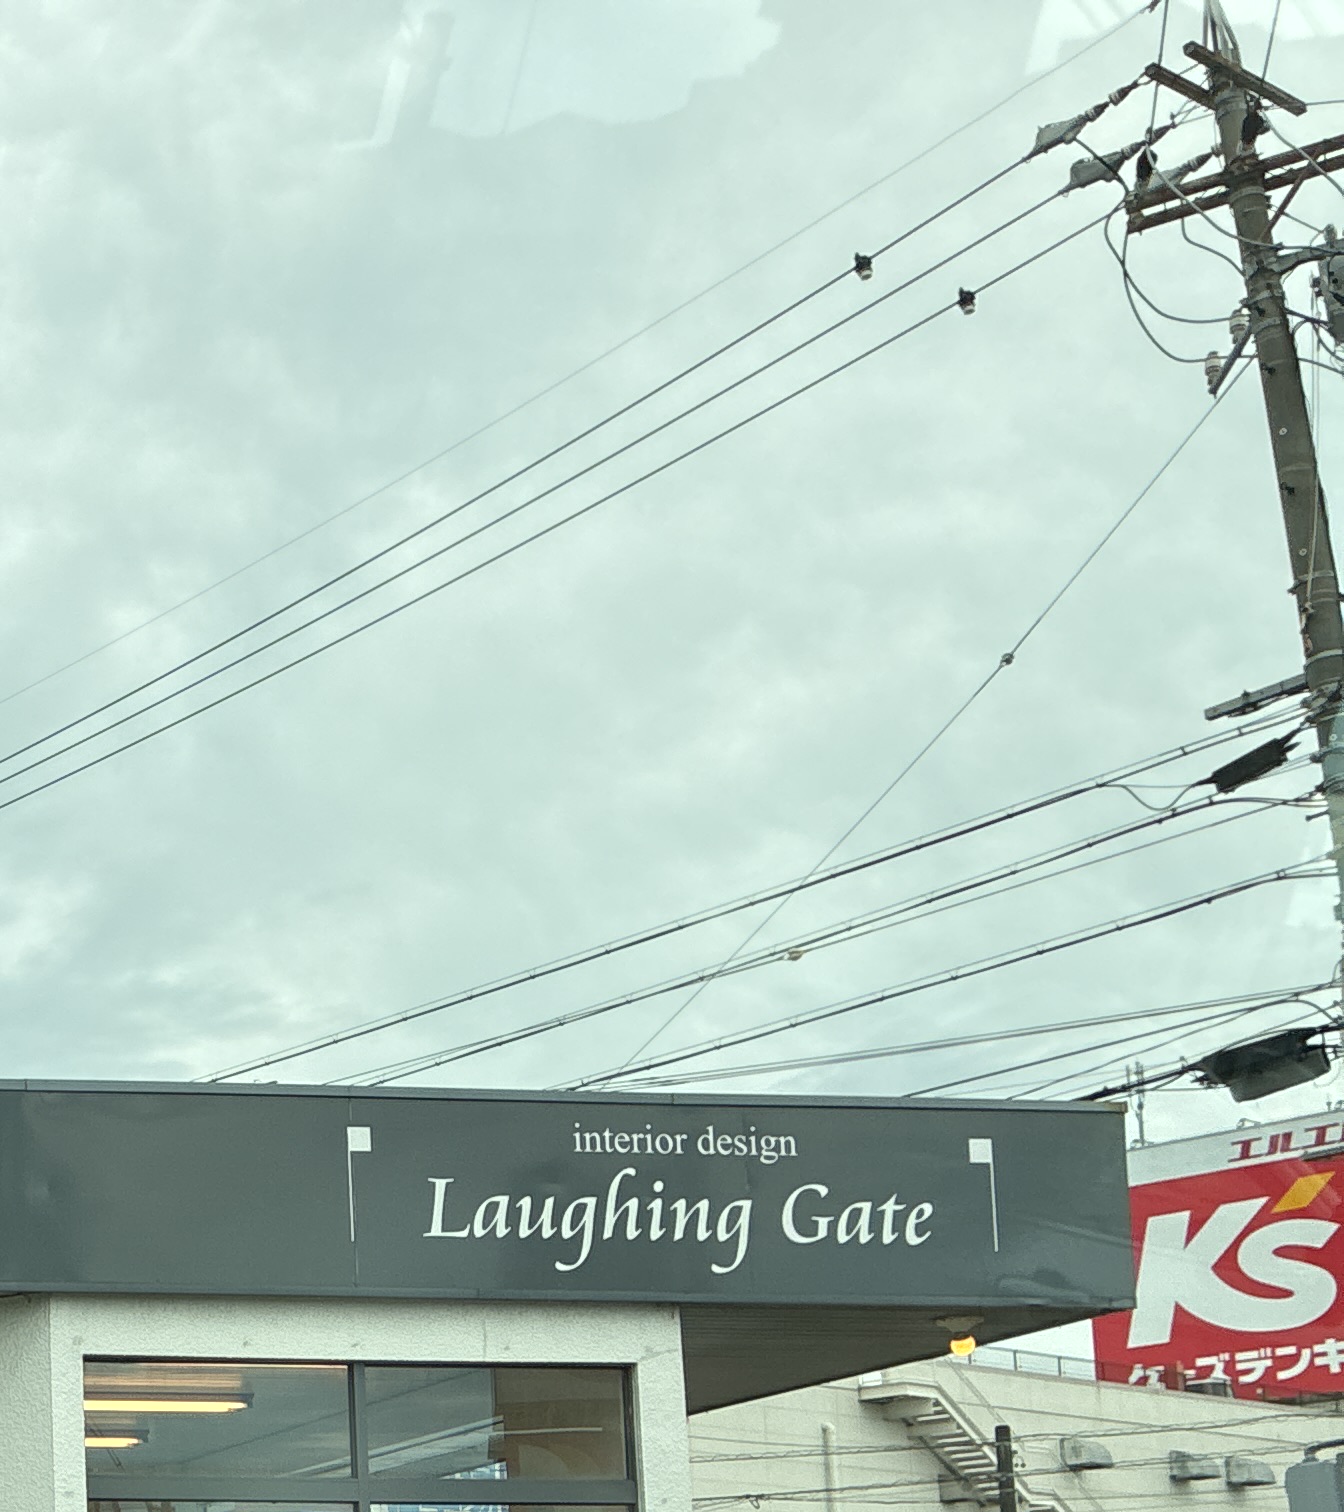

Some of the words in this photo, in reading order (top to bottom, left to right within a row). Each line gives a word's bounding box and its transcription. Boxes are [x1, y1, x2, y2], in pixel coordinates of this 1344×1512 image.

[572, 1122, 688, 1157] interior
[696, 1124, 799, 1165] design
[1227, 1120, 1344, 1163] エルエ
[422, 1167, 752, 1275] Laughing
[781, 1182, 934, 1247] Gate
